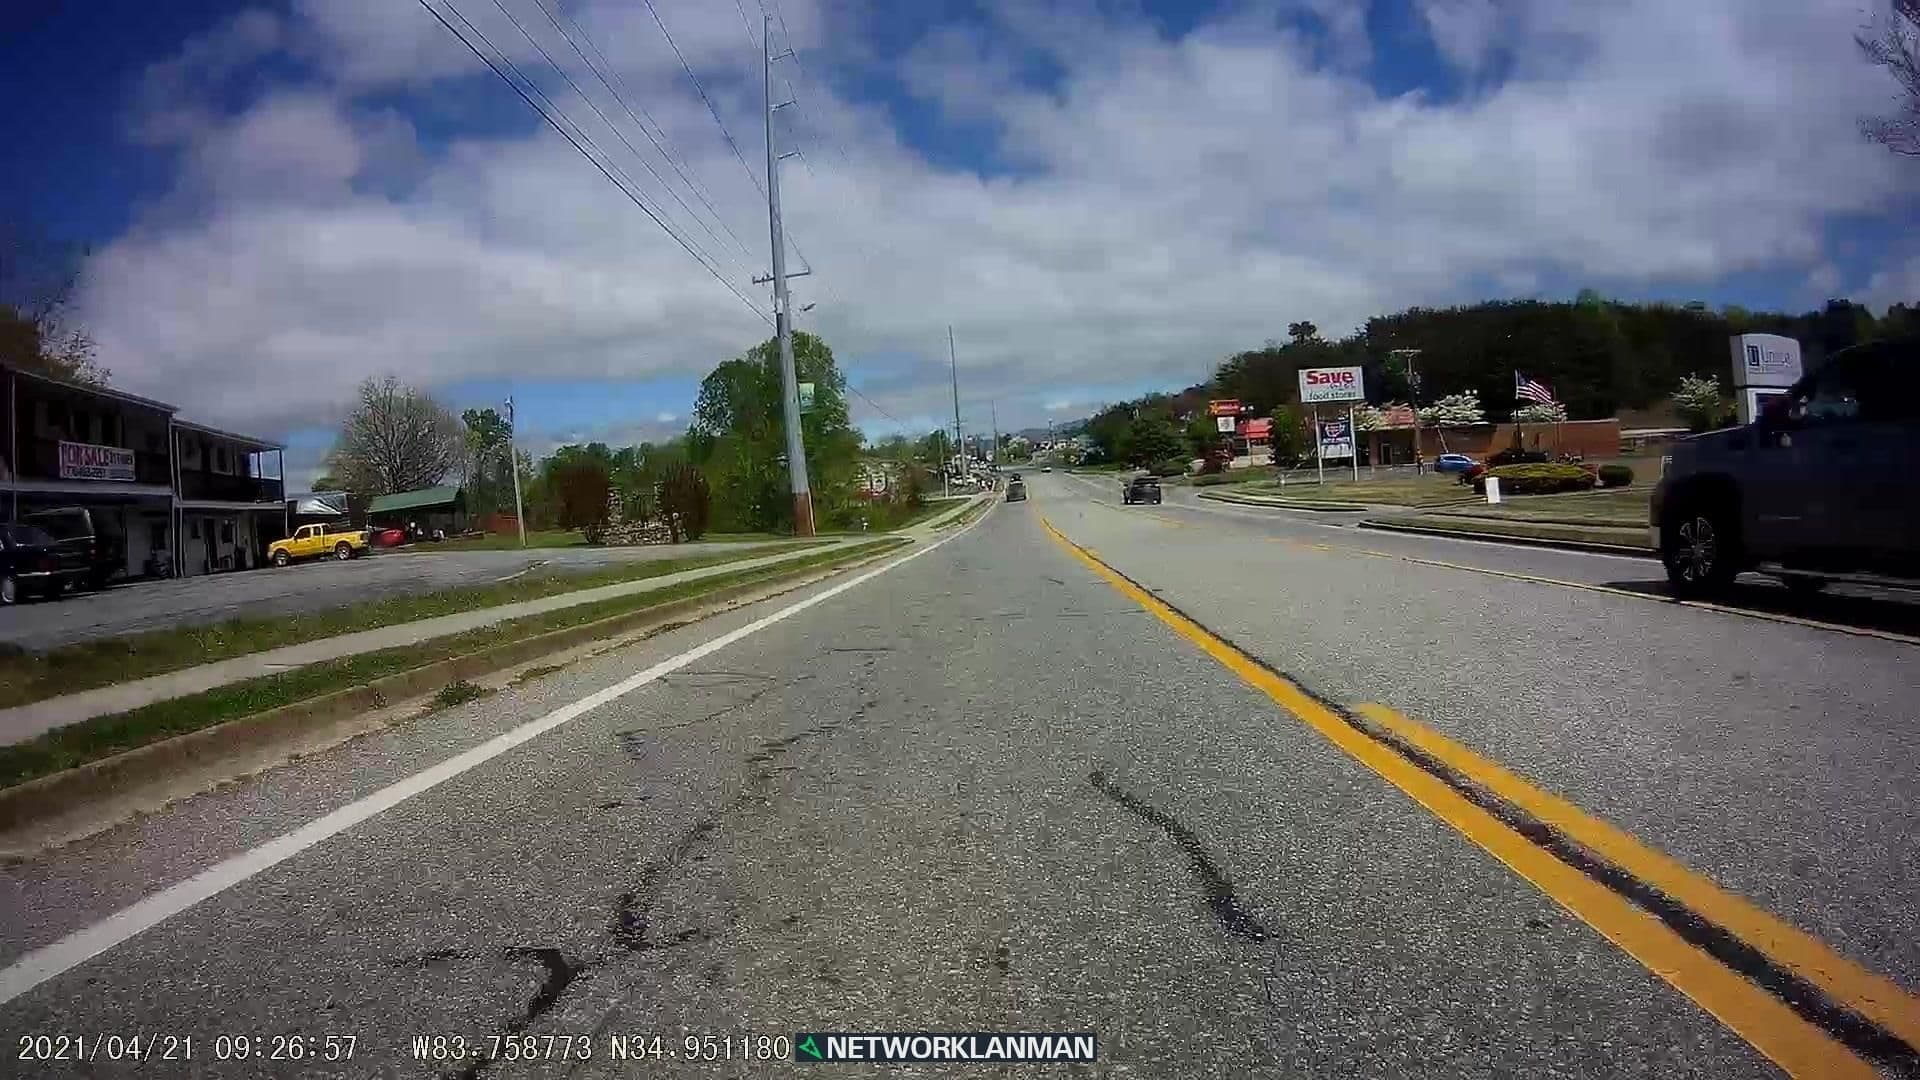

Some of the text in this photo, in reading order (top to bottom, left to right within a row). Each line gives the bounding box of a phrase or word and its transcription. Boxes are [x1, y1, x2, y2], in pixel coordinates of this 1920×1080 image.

[1306, 370, 1353, 385] Save
[1309, 391, 1329, 401] food
[84, 446, 110, 466] SALE
